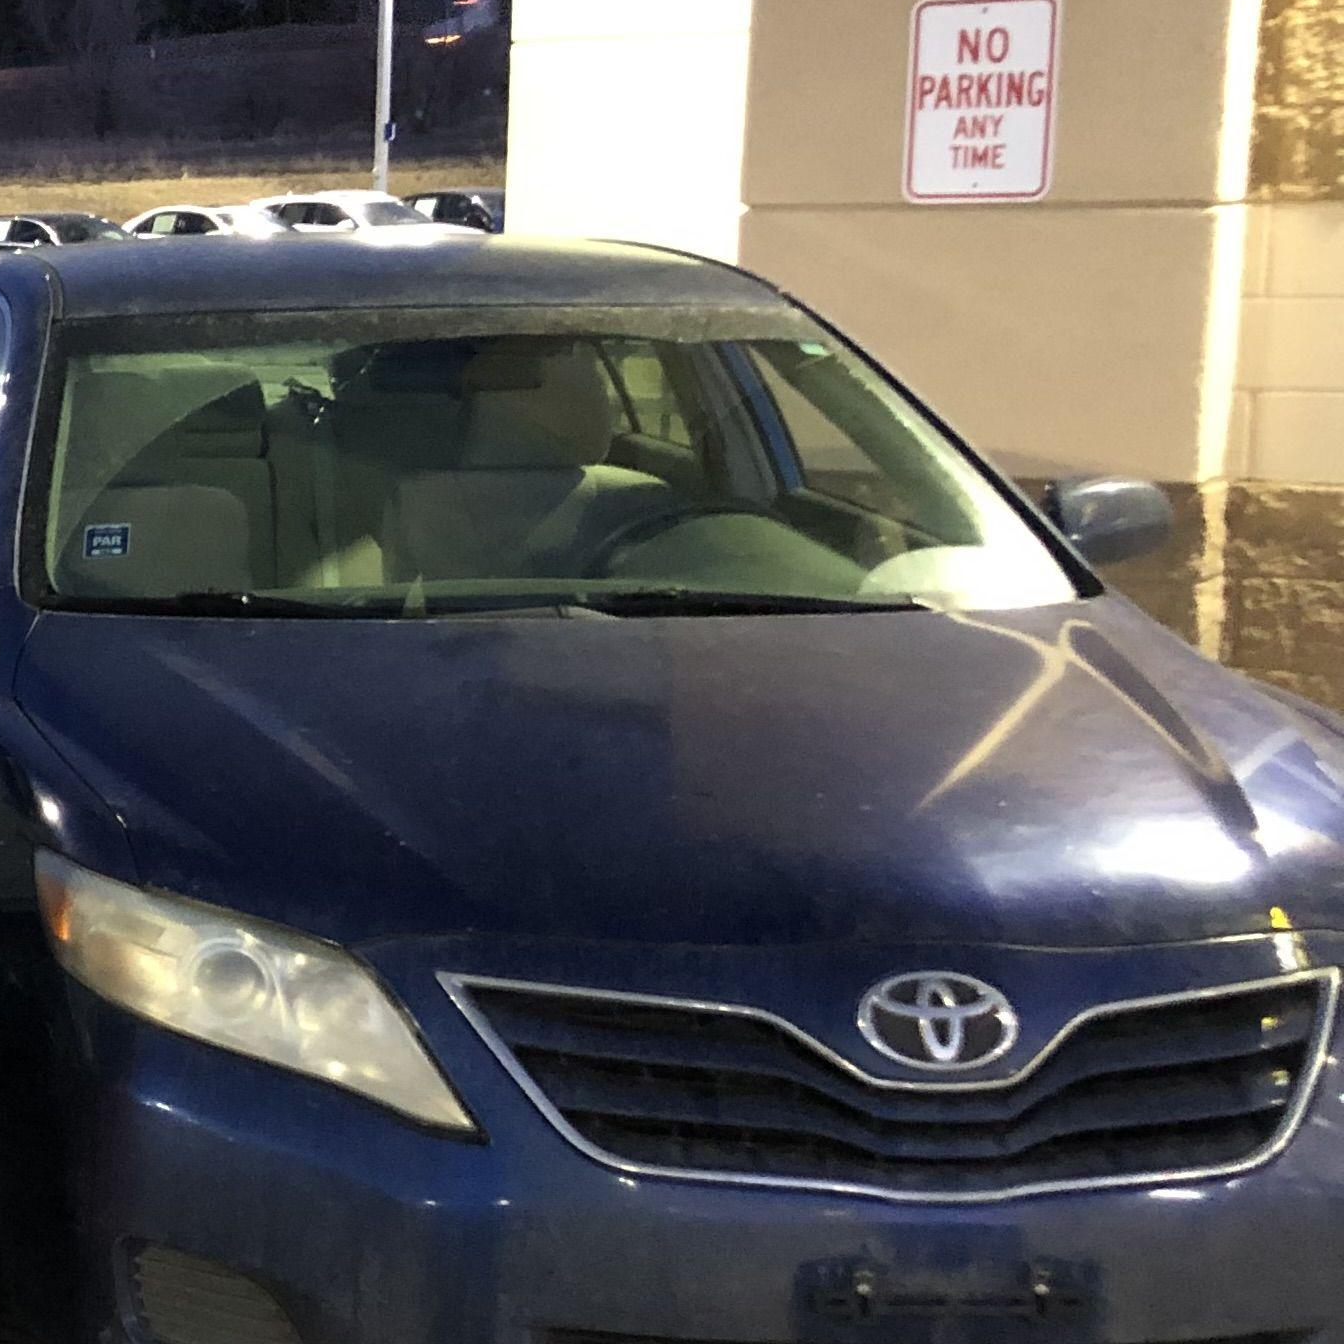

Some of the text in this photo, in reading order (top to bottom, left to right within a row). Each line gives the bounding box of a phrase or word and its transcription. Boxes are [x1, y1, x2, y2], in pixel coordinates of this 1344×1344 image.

[957, 27, 1009, 64] NO
[918, 71, 1045, 109] PARKING
[953, 115, 1004, 138] ANY
[950, 144, 1007, 169] TIME
